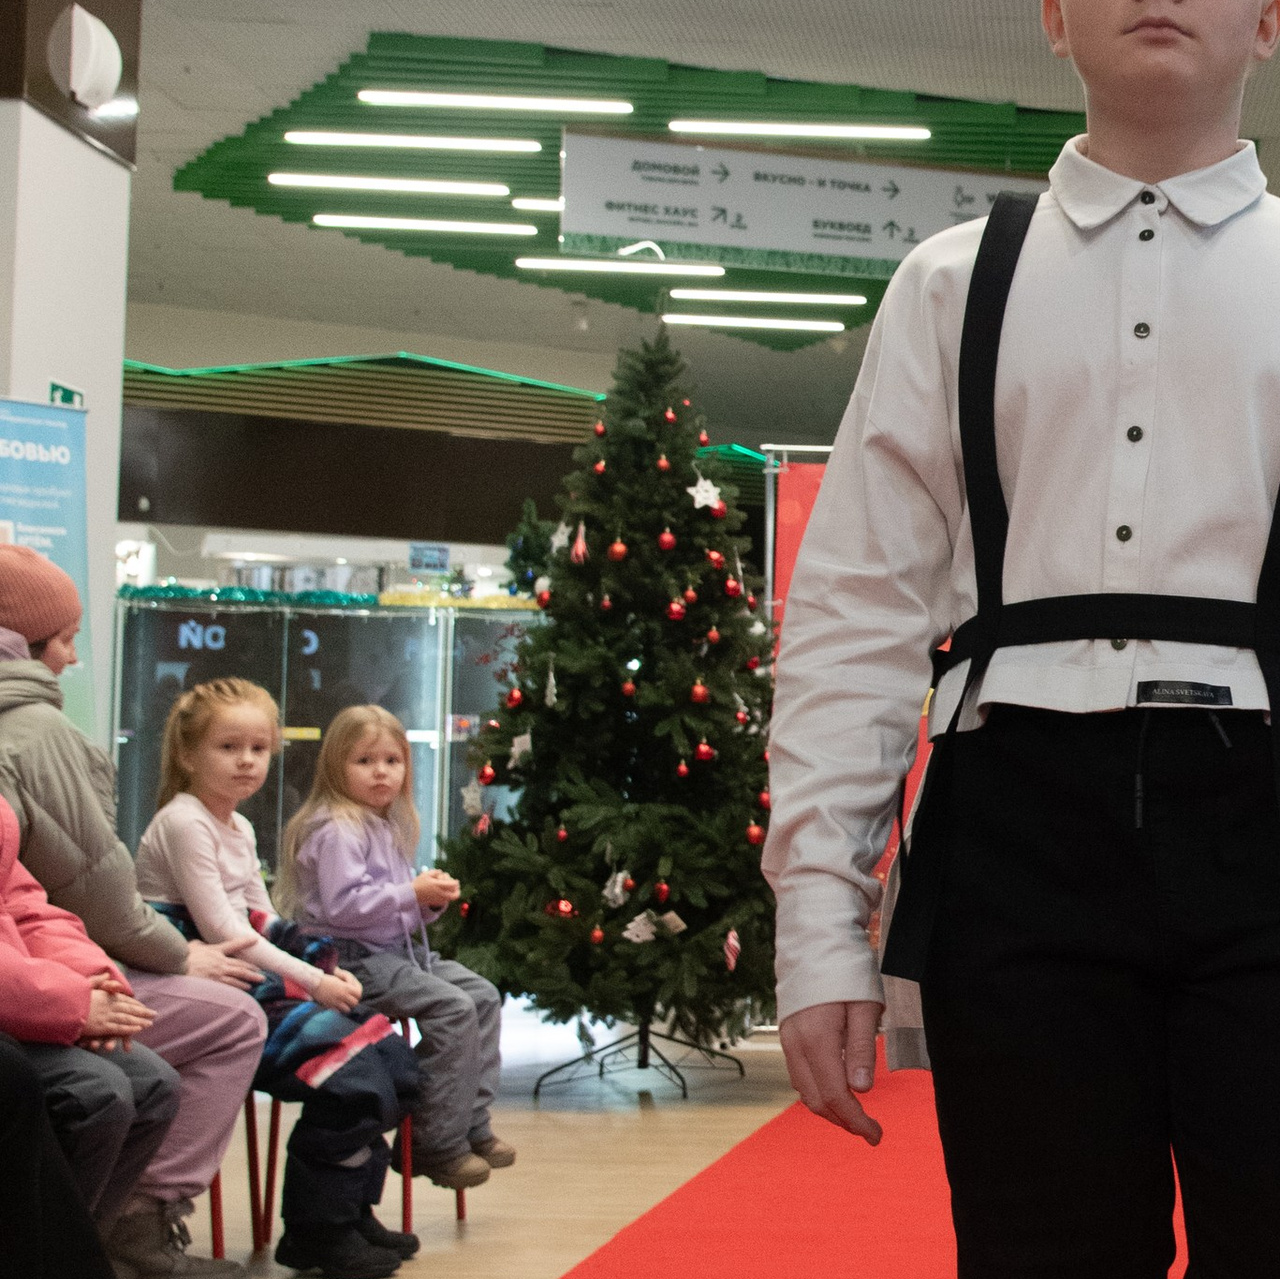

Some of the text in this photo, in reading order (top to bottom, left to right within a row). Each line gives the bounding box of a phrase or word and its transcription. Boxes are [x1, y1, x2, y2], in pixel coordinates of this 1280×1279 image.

[632, 159, 700, 175] ДОМОВОЙ
[753, 171, 806, 186] ВКУСНО
[817, 177, 827, 188] И
[830, 179, 872, 193] ТОЧКА
[605, 200, 698, 218] ФИТНЕС ХАУС
[812, 219, 872, 234] БУКВОЕД
